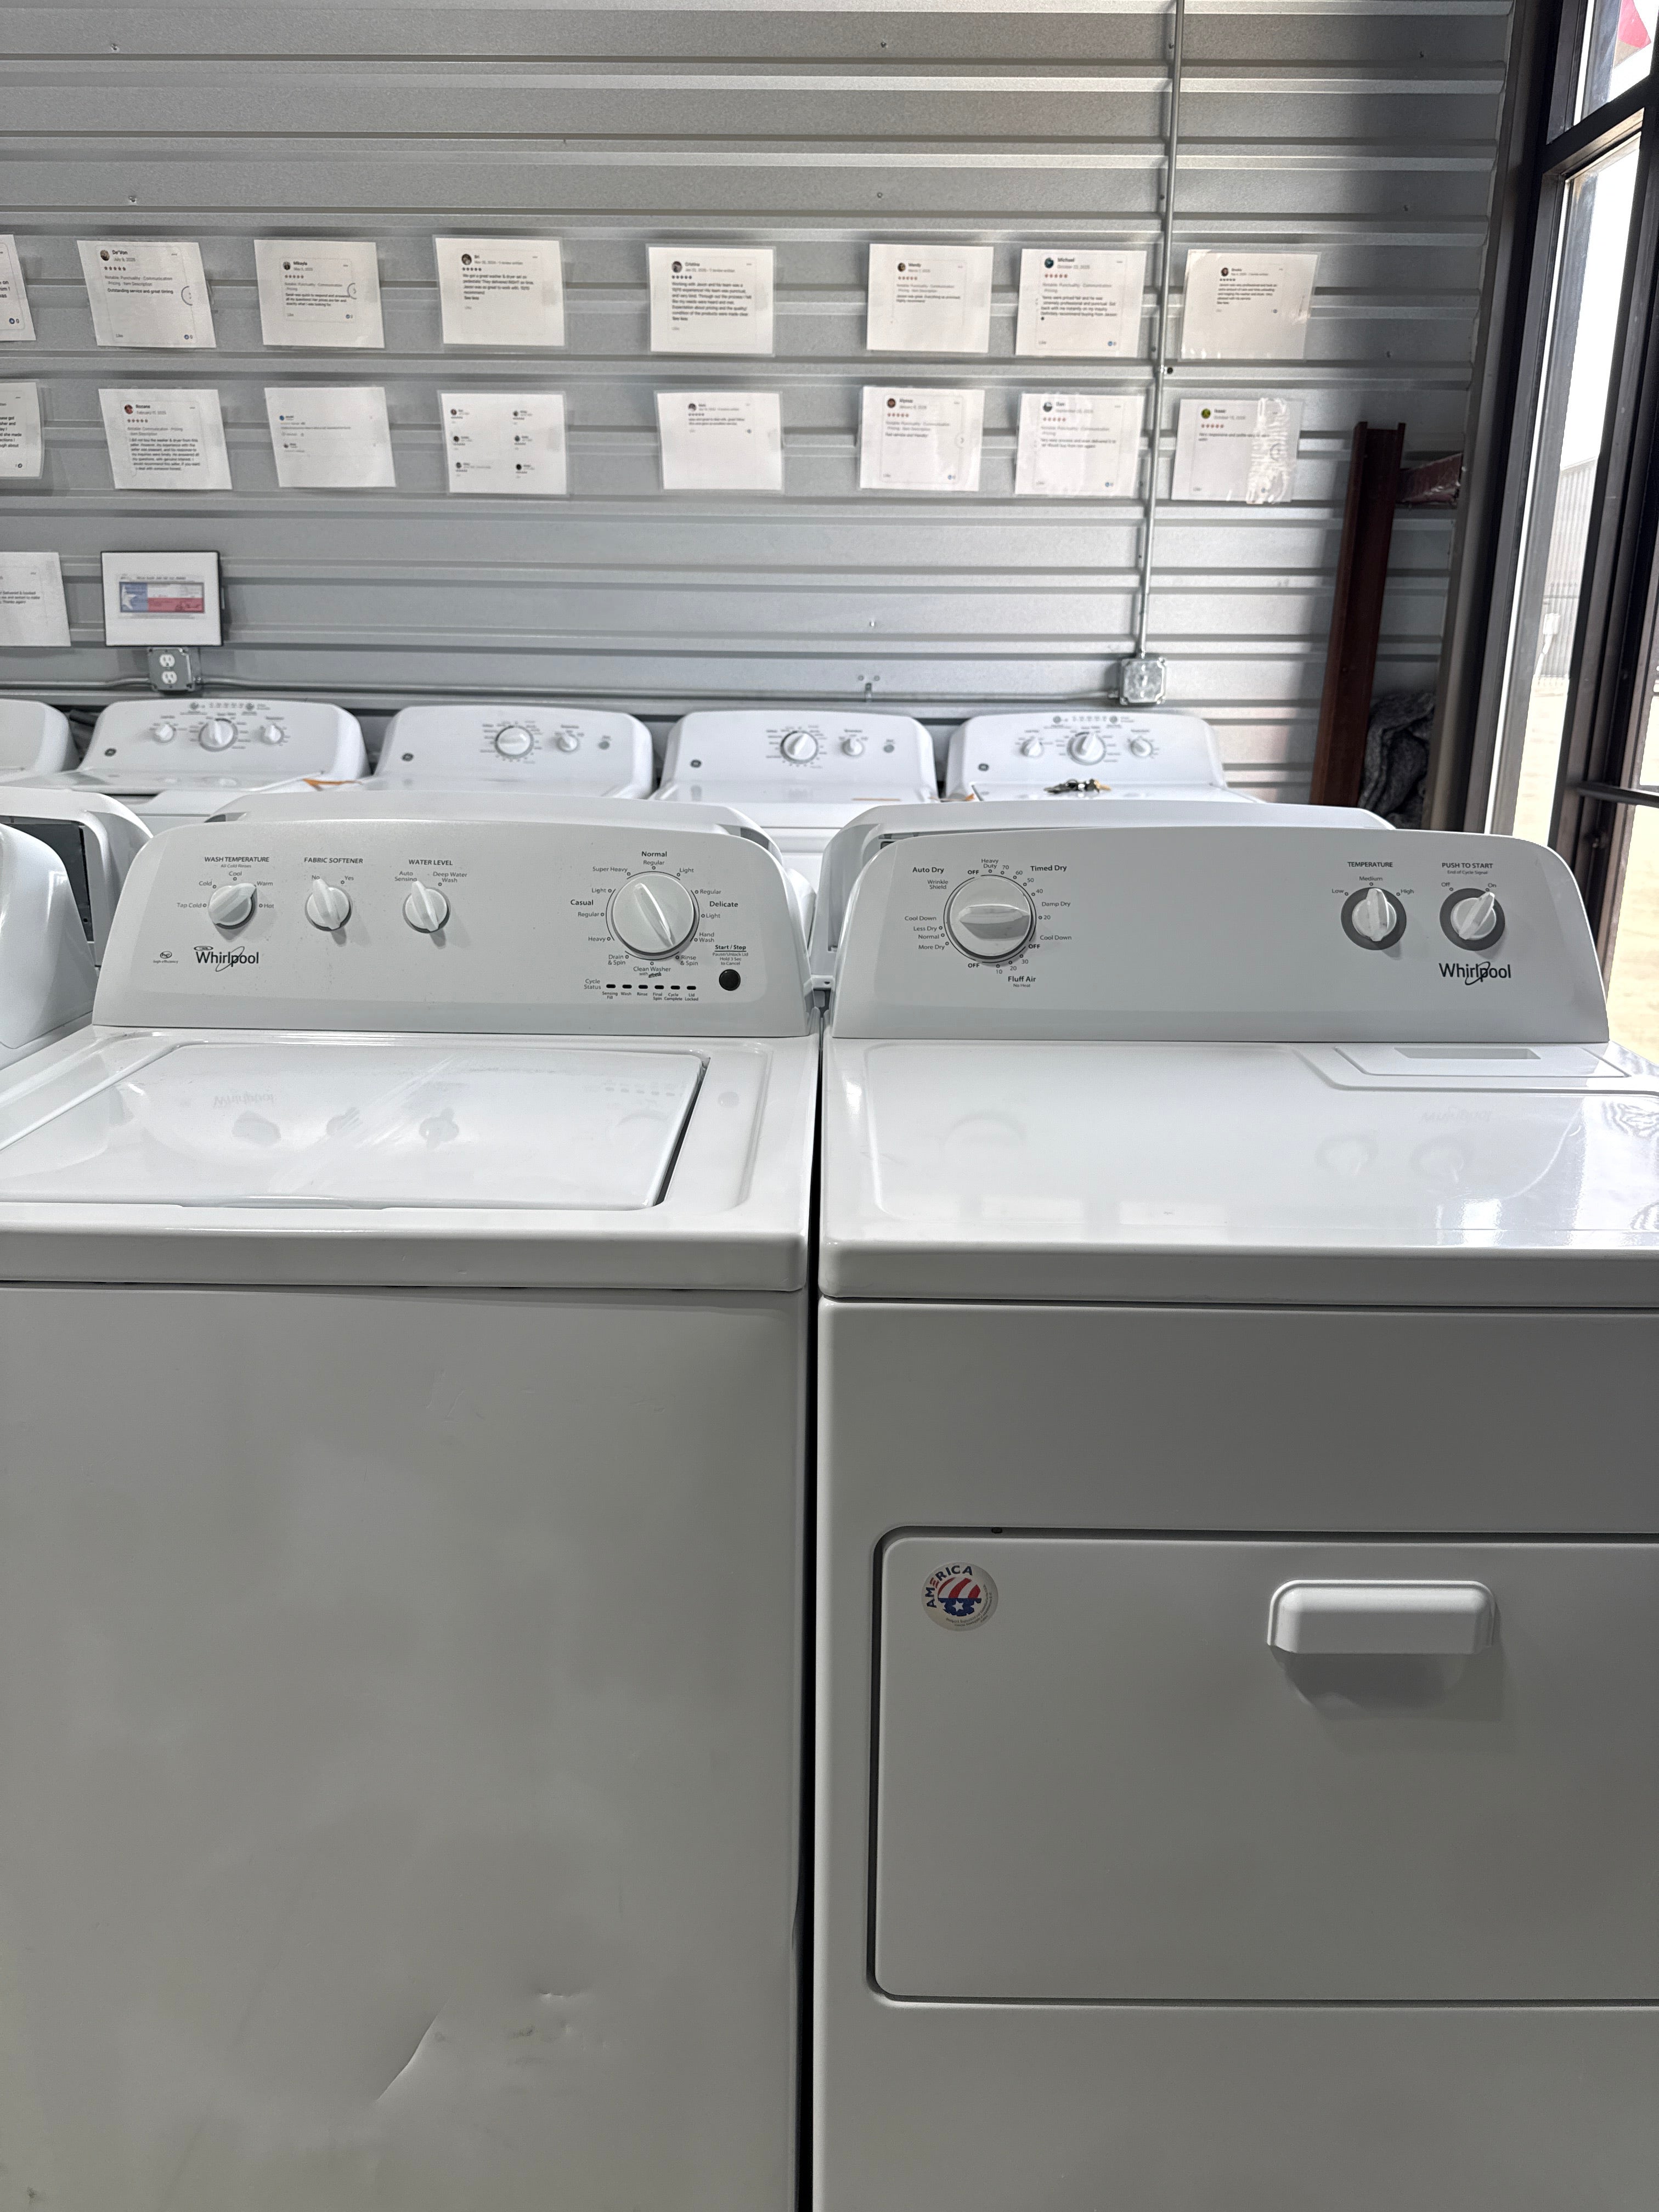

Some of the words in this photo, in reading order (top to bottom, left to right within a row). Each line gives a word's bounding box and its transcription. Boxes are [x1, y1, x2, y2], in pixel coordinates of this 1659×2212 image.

[196, 951, 259, 967] Whirlpool
[1438, 963, 1511, 983] Whirlpool
[925, 1566, 973, 1608] AMERICA
